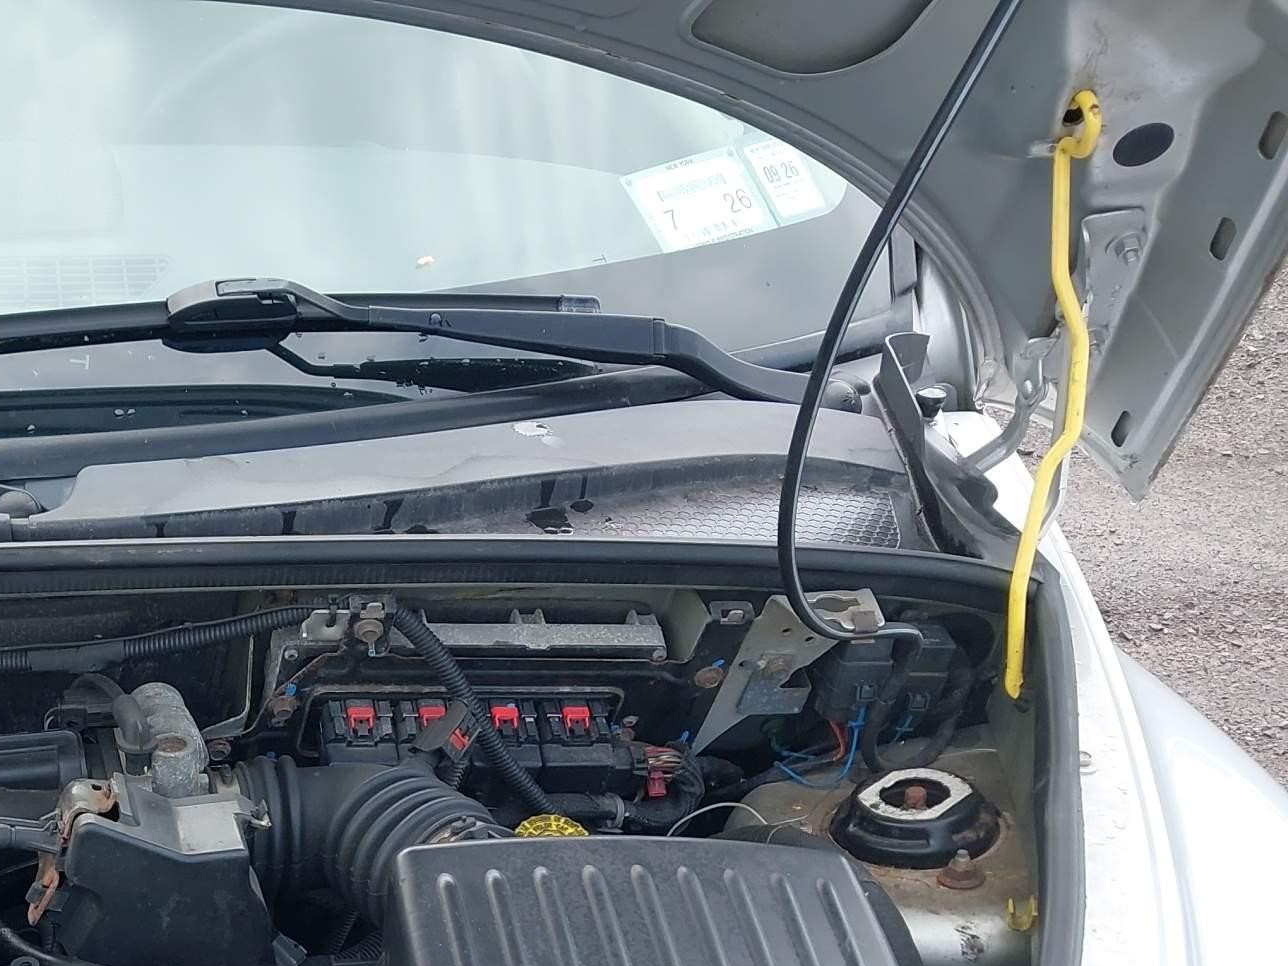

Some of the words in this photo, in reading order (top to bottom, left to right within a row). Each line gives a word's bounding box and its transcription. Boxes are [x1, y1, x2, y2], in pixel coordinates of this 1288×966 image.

[763, 165, 782, 183] 09
[780, 160, 800, 178] 26
[663, 208, 678, 231] 7
[723, 188, 753, 214] 26
